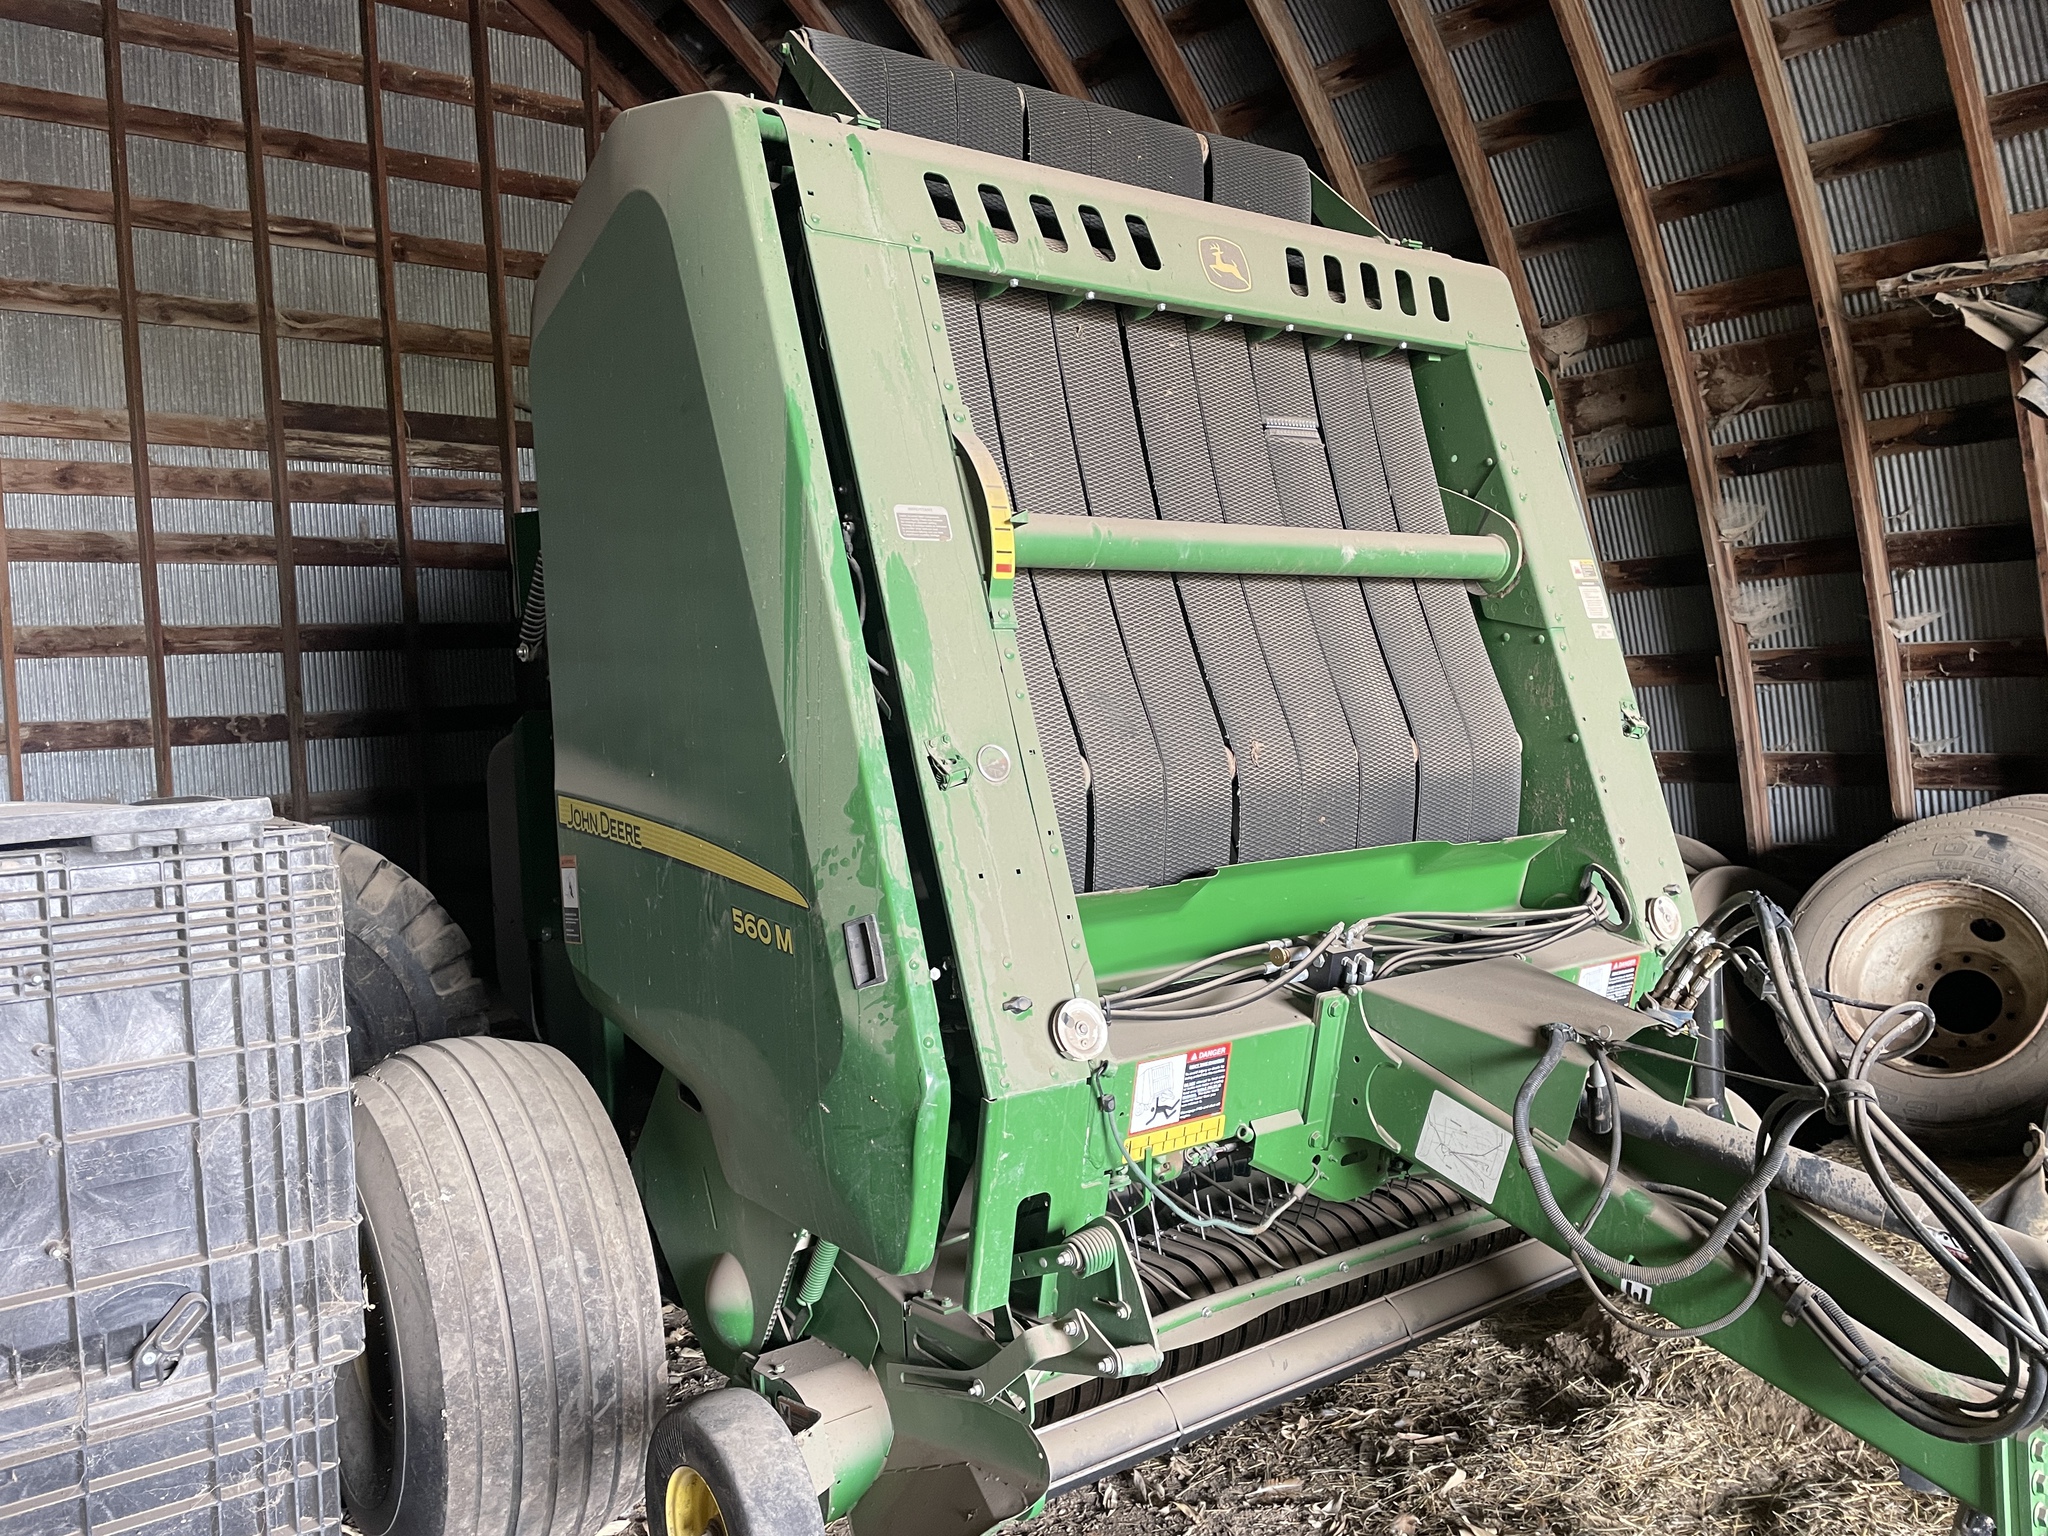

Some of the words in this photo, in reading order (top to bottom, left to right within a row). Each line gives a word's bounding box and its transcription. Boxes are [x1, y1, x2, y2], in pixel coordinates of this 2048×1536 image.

[567, 803, 598, 832] JOHN
[600, 811, 642, 846] DEERE
[731, 906, 772, 945] 560
[775, 923, 794, 955] M
[1198, 1047, 1226, 1059] DANGER
